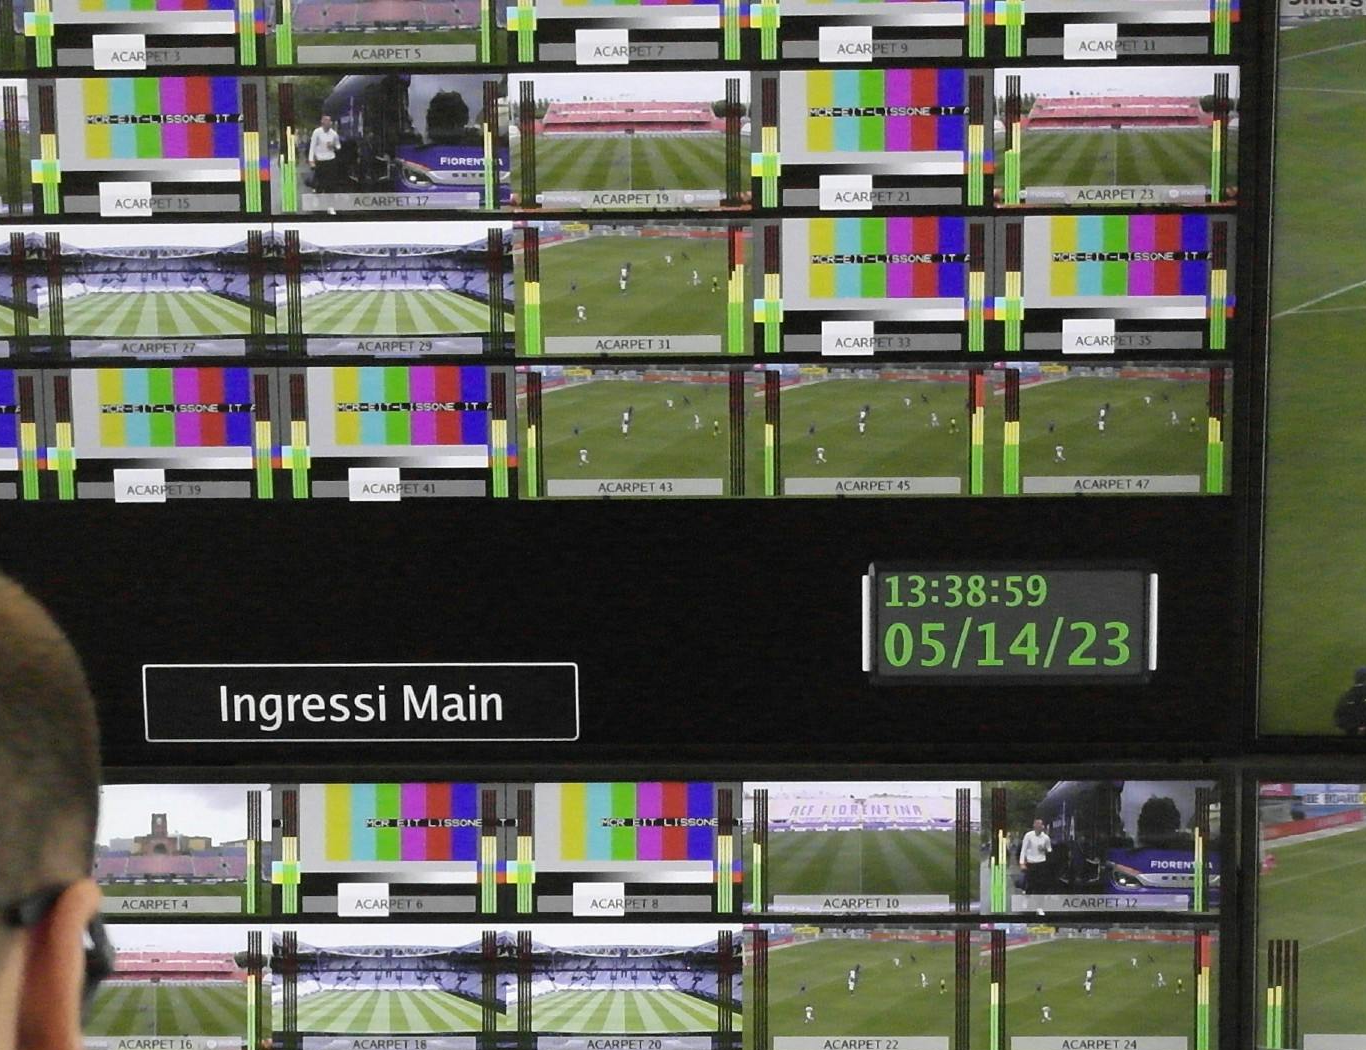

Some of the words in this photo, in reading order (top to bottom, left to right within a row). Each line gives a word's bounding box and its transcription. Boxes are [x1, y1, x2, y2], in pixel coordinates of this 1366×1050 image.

[1079, 40, 1138, 52] ACARPET
[1142, 40, 1156, 51] 11
[352, 48, 410, 60] ACARPET
[414, 48, 422, 59] 5
[592, 194, 654, 205] ACARPET
[657, 193, 670, 204] 19
[834, 191, 895, 202] ACARPET
[898, 190, 910, 202] 21
[1078, 189, 1136, 200] ACARPET
[1140, 189, 1154, 200] 23
[115, 199, 175, 210] ACARPET
[177, 198, 190, 209] 15
[353, 196, 414, 207] ACARPET
[417, 196, 429, 207] 17
[121, 342, 181, 353] ACARPET
[182, 342, 196, 353] 27
[357, 341, 416, 352] ACARPET
[419, 341, 432, 351] 29
[596, 339, 653, 350] ACARPET
[658, 339, 671, 350] 31
[835, 337, 894, 348] ACARPET
[897, 337, 911, 347] 33
[362, 483, 421, 495] ACARPET
[424, 483, 436, 494] 41
[598, 482, 659, 493] ACARPET
[661, 482, 673, 493] 43
[835, 481, 896, 492] ACARPET
[898, 480, 911, 491] 45
[1073, 479, 1134, 490] ACARPET
[1137, 479, 1150, 489] 47
[127, 485, 186, 496] ACARPET
[189, 485, 201, 495] 39
[883, 574, 1048, 609] 13:38:59
[883, 620, 1131, 670] 05/14/23
[219, 684, 387, 732] Ingressi
[403, 683, 504, 723] Main
[121, 899, 178, 910] ACARPET
[180, 899, 188, 909] 4
[355, 898, 412, 910] ACARPET
[415, 898, 423, 909] 6
[590, 899, 648, 909] ACARPET
[652, 898, 659, 909] 8
[823, 898, 881, 909] ACARPET
[885, 898, 899, 908] 10
[1062, 898, 1119, 908] ACARPET
[1125, 898, 1138, 907] 12
[118, 1039, 176, 1050] ACARPET
[179, 1038, 193, 1049] 16
[353, 1039, 411, 1050] ACARPET
[414, 1039, 427, 1049] 18
[587, 1039, 645, 1050] ACARPET
[648, 1039, 662, 1050] 20
[824, 1039, 881, 1050] ACARPET
[885, 1039, 899, 1049] 22
[1062, 1039, 1119, 1050] ACARPET
[1121, 1039, 1137, 1049] 24
